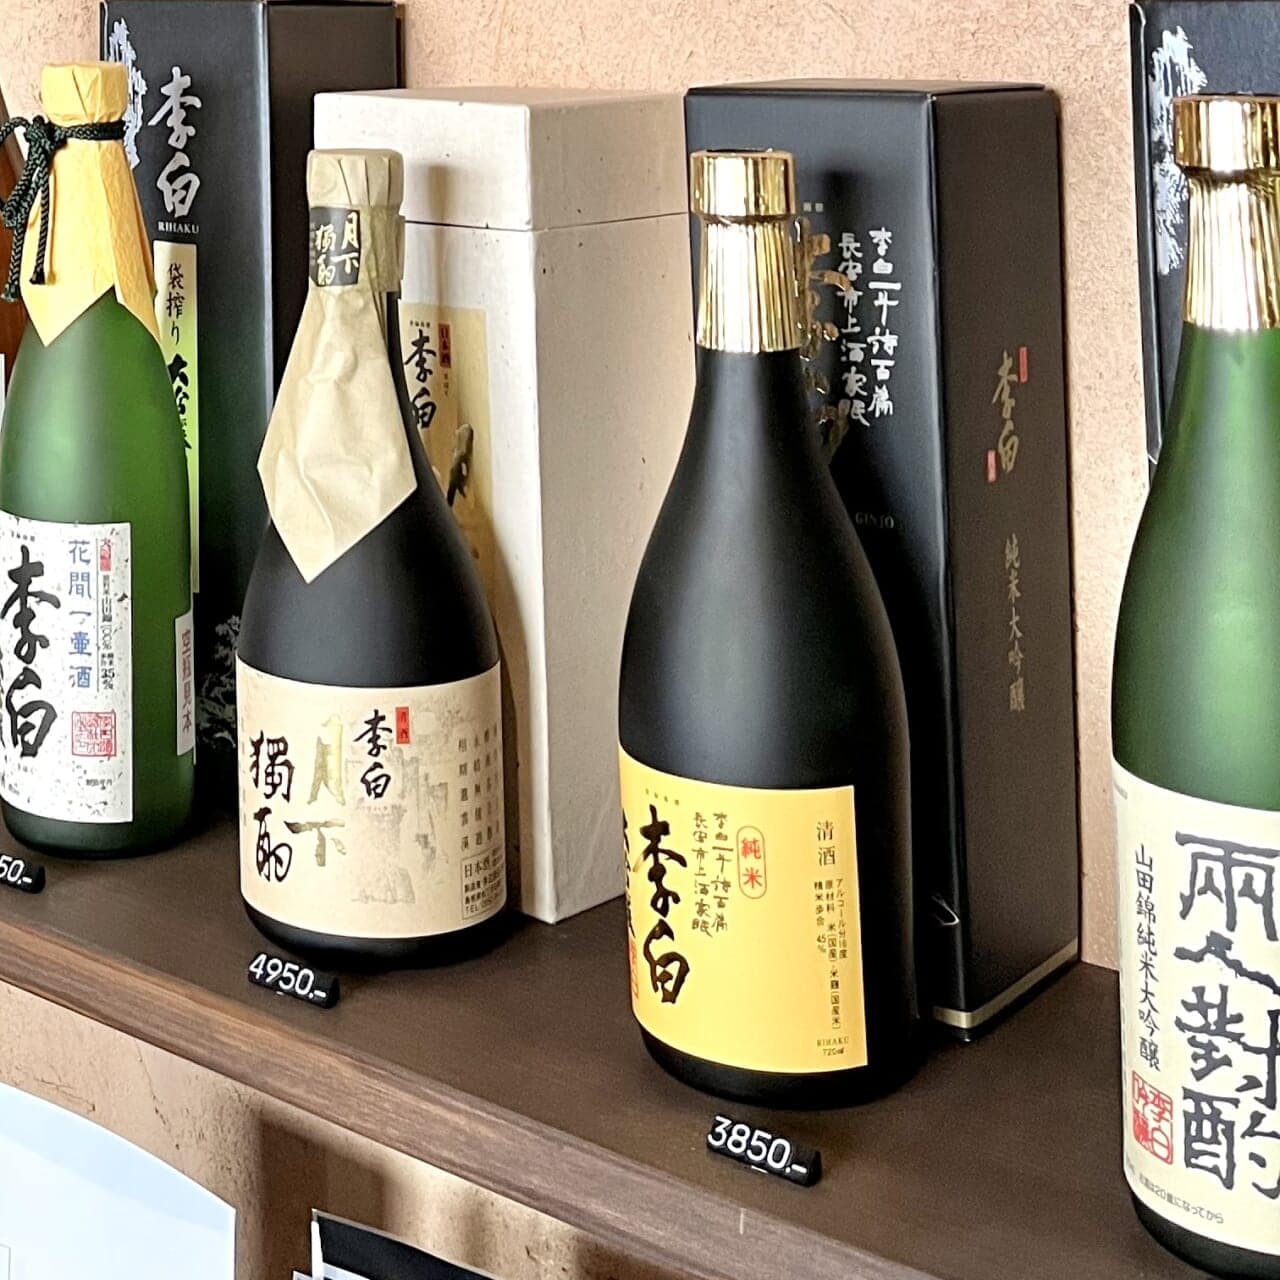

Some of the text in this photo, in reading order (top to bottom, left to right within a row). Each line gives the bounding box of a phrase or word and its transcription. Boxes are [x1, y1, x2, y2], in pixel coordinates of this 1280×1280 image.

[148, 66, 202, 218] 李白
[158, 221, 200, 234] RIHAKU
[166, 262, 185, 346] 袋搾り
[405, 327, 438, 429] 李白
[993, 349, 1019, 475] 李白
[0, 544, 62, 758] 李白
[284, 714, 347, 868] 月下
[353, 709, 393, 800] 李白
[741, 837, 763, 890] 純米
[816, 820, 836, 867] 清酒
[632, 803, 691, 1005] 李白
[248, 953, 328, 1002] 4950.-
[1135, 842, 1161, 1074] 山田錦純米大吟醸
[707, 1115, 810, 1176] 3850.-
